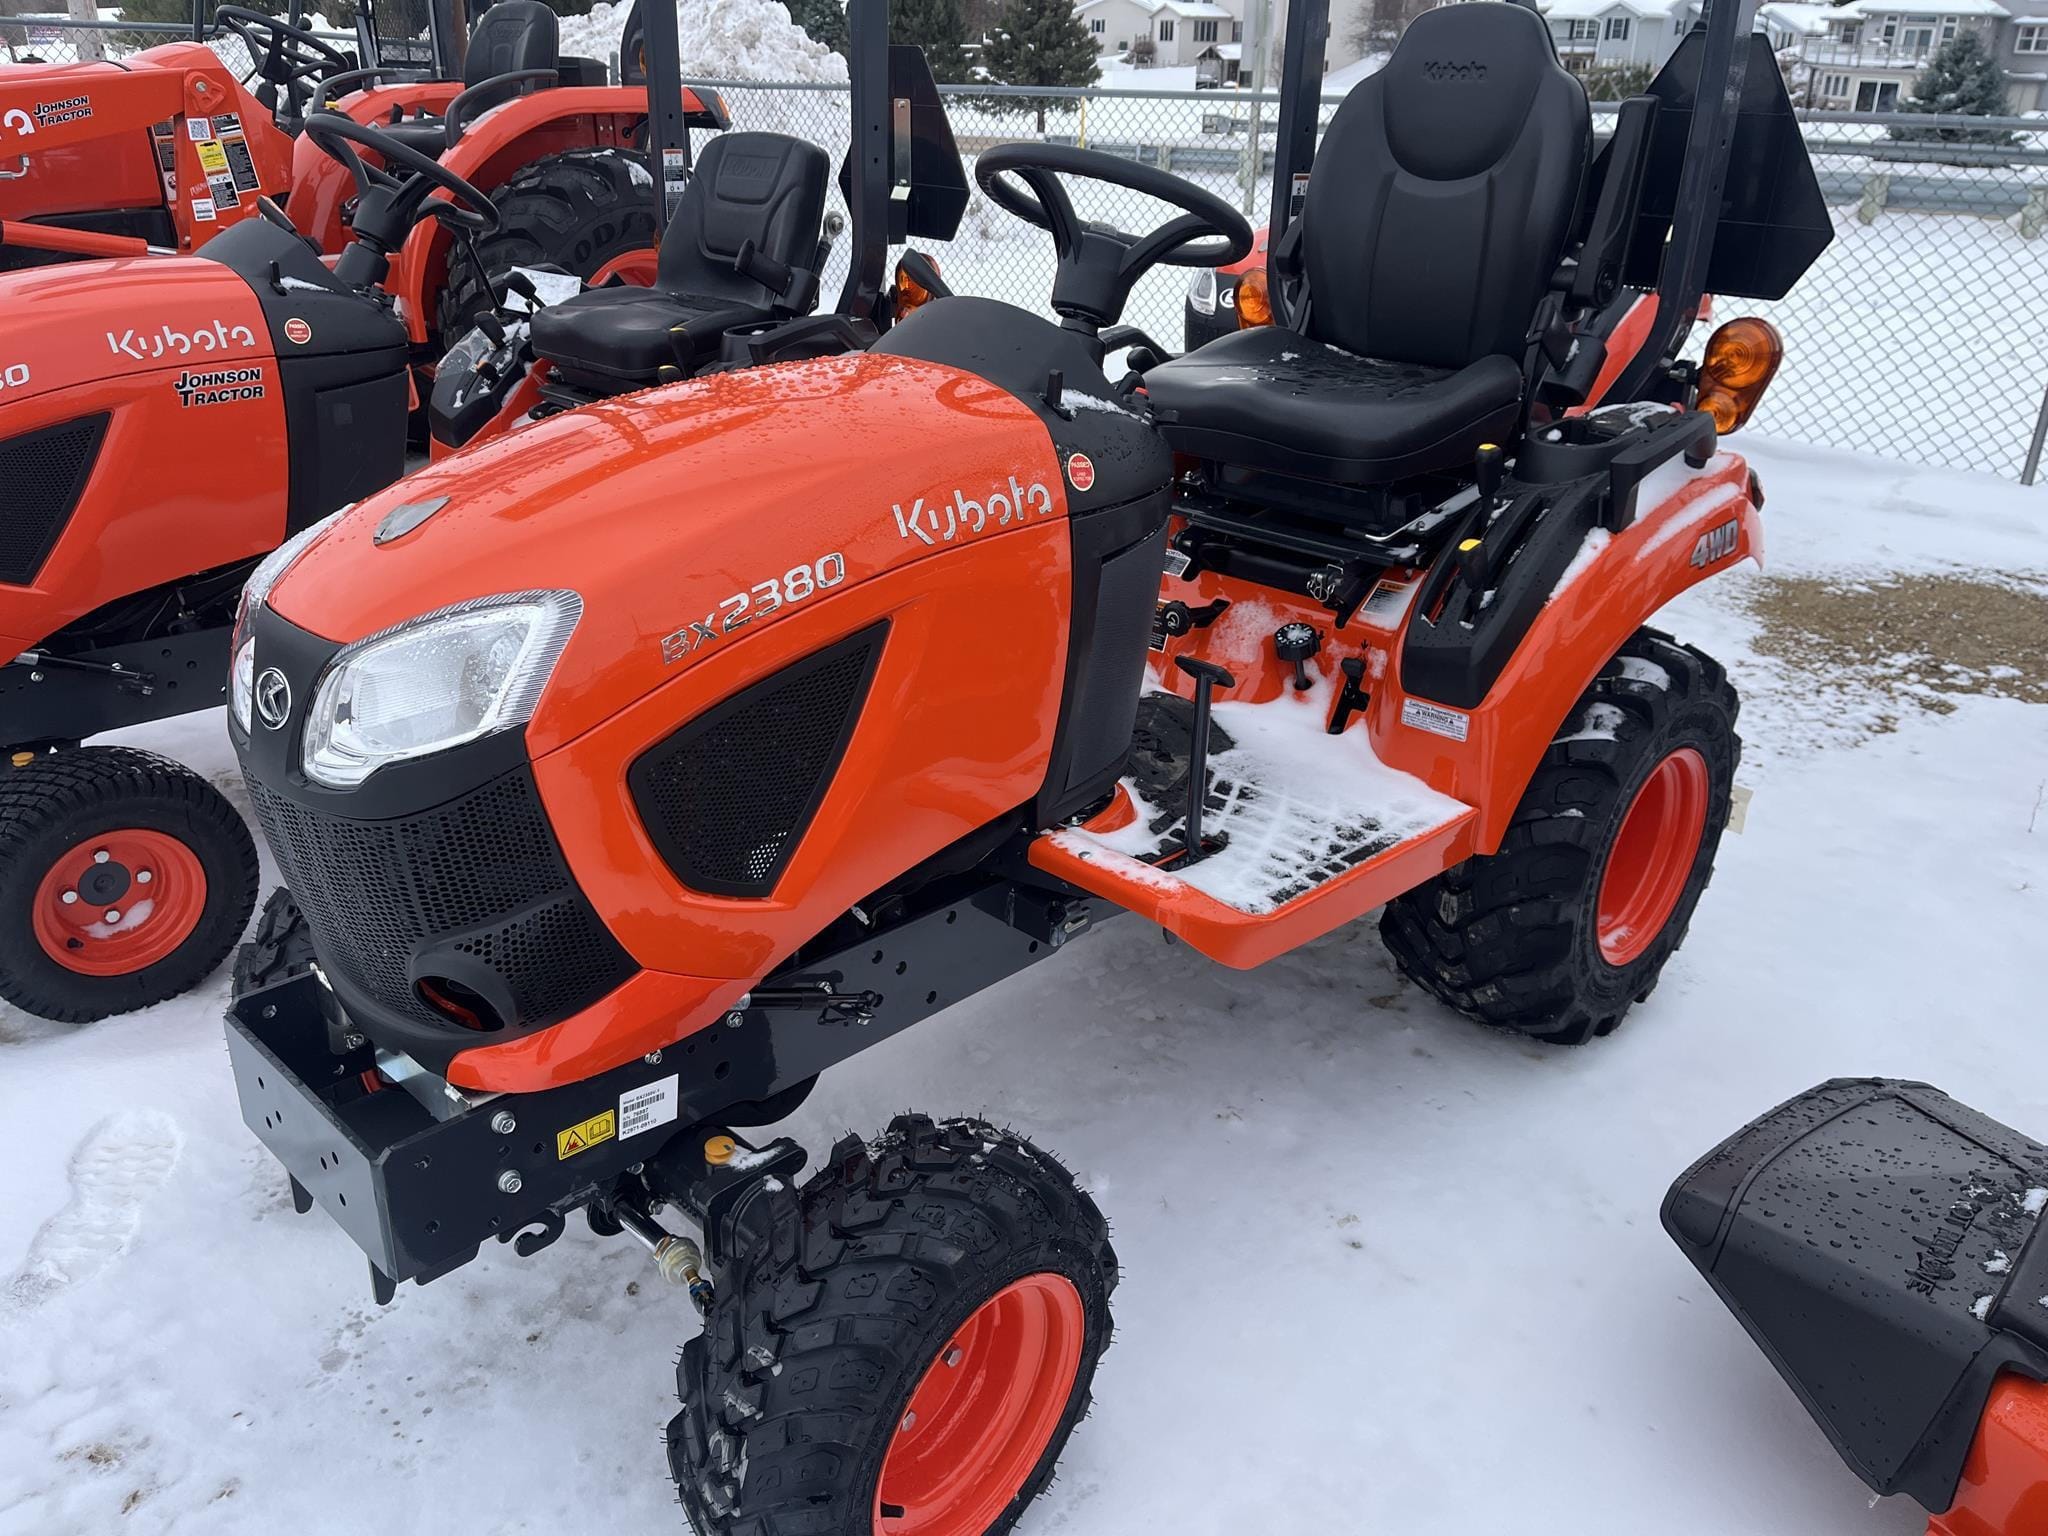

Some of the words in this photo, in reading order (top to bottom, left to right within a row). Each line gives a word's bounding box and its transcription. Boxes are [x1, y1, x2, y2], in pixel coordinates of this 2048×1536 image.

[1424, 60, 1488, 81] Kubota
[33, 95, 89, 117] JOHNSON
[37, 107, 93, 127] TRACTOR
[106, 319, 256, 360] Kubota
[174, 366, 263, 392] JOHNSON
[178, 385, 265, 408] TRACTOR
[892, 476, 1053, 546] Kubota
[1689, 518, 1739, 569] 4WD
[660, 552, 846, 666] BX2380
